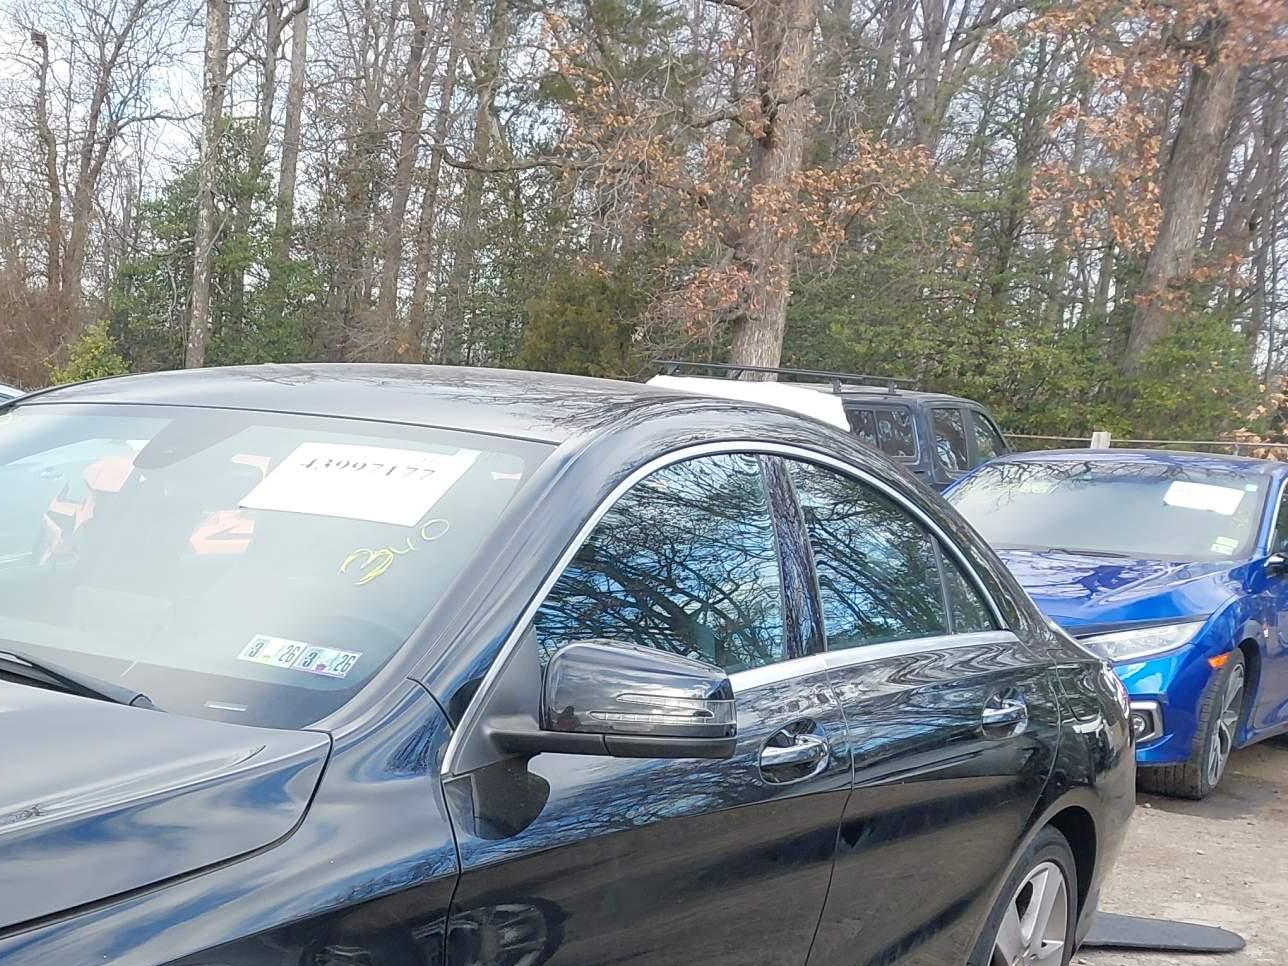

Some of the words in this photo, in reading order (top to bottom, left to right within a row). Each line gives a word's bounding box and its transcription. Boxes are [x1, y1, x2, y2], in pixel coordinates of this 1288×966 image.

[300, 458, 436, 481] 43997177
[302, 651, 318, 668] 3
[333, 653, 357, 674] 26
